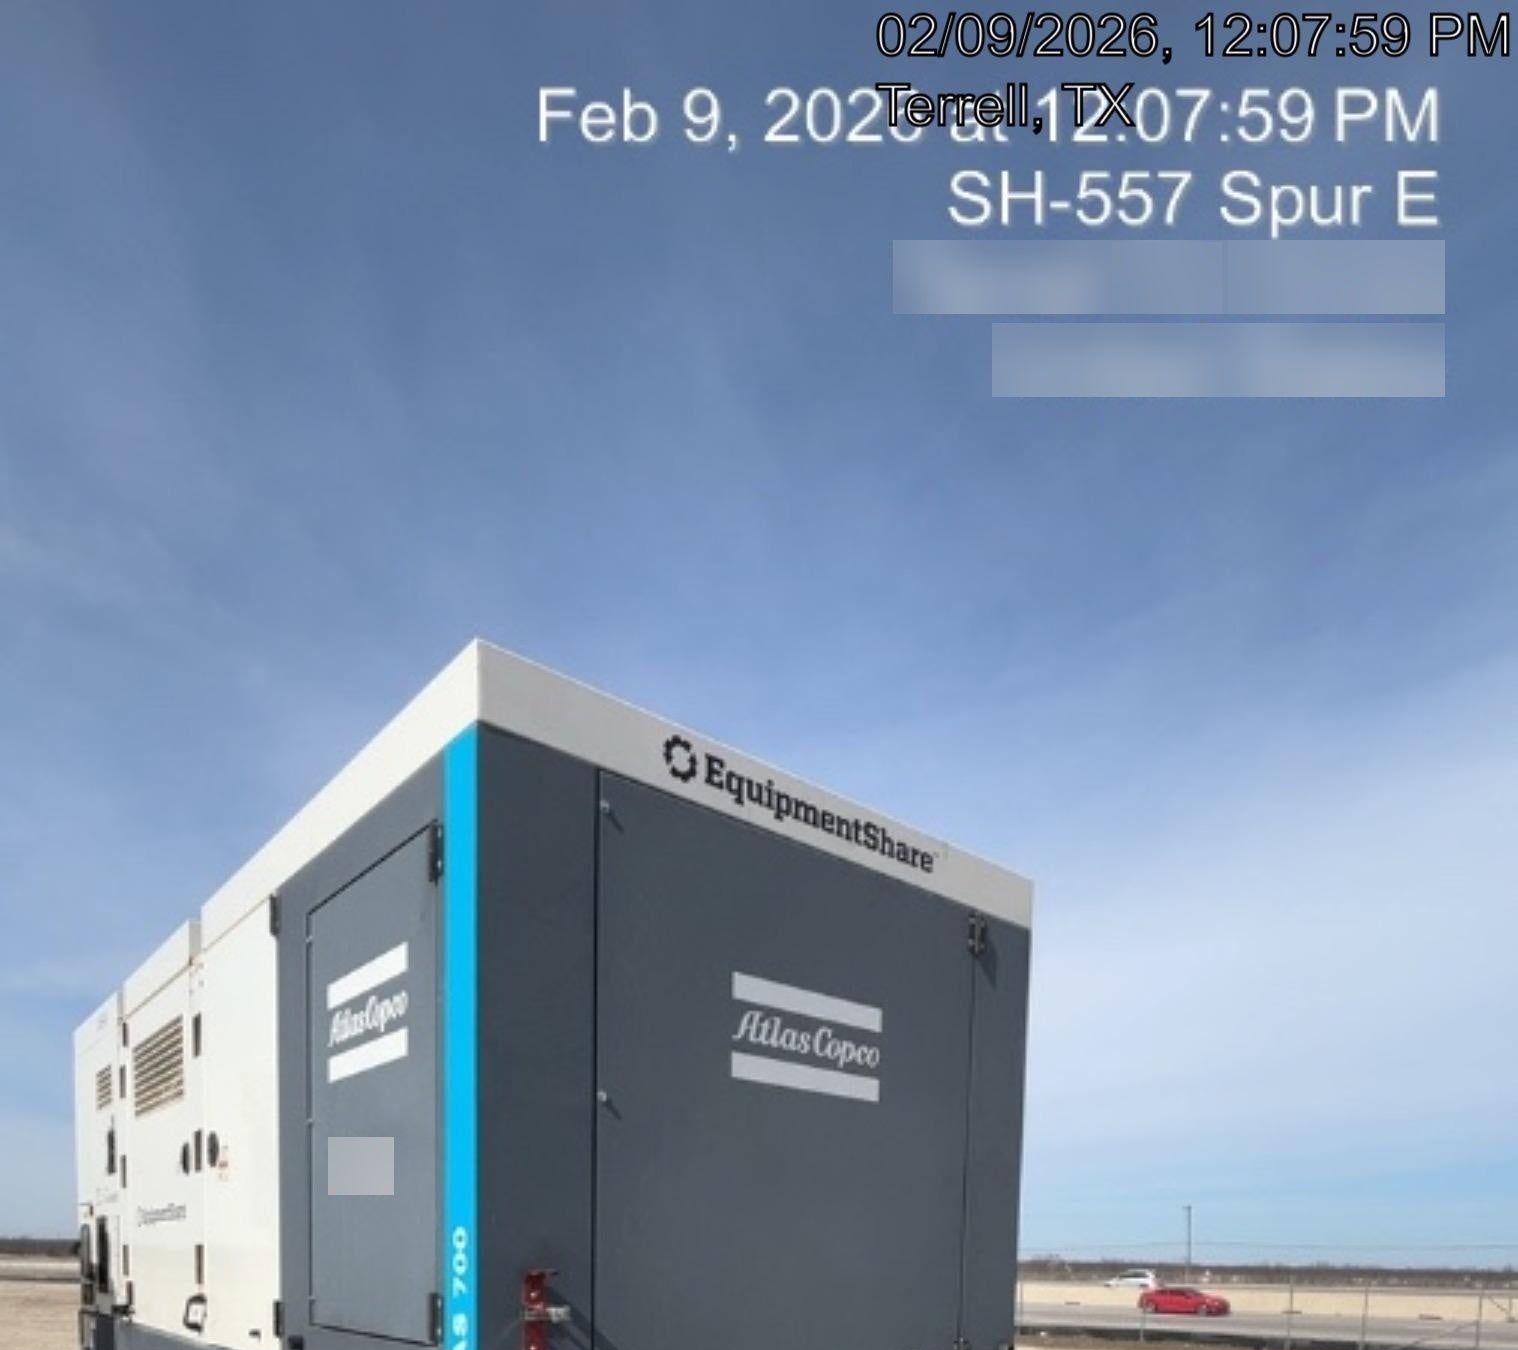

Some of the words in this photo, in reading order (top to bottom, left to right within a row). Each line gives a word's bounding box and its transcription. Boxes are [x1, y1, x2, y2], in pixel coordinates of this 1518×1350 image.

[704, 752, 935, 873] EquipmentShare
[732, 1010, 811, 1054] Atlas
[813, 1026, 880, 1068] Copco
[452, 1226, 468, 1298] 700
